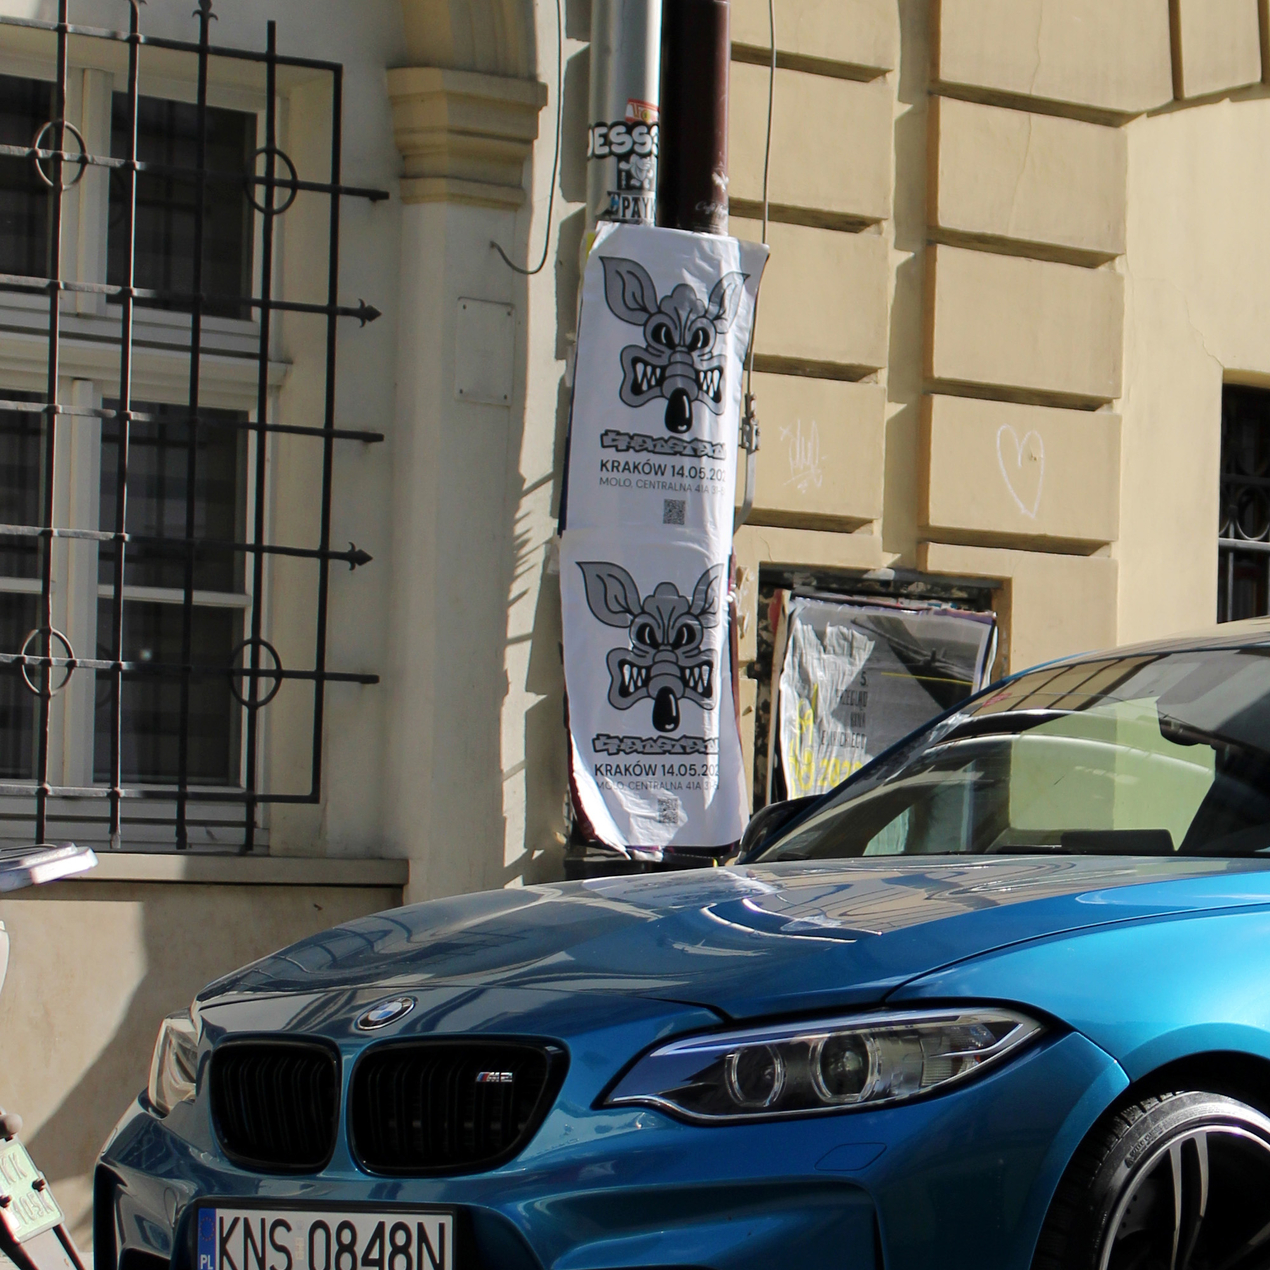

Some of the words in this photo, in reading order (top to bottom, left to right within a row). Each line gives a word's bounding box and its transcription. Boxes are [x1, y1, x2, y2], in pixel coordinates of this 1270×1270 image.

[600, 458, 667, 476] KRAKÓW
[636, 479, 692, 492] CENTRALNA
[594, 760, 658, 776] KRAKÓW
[628, 781, 683, 790] CENTRALNA
[685, 781, 702, 790] 41A
[200, 1254, 213, 1270] PL
